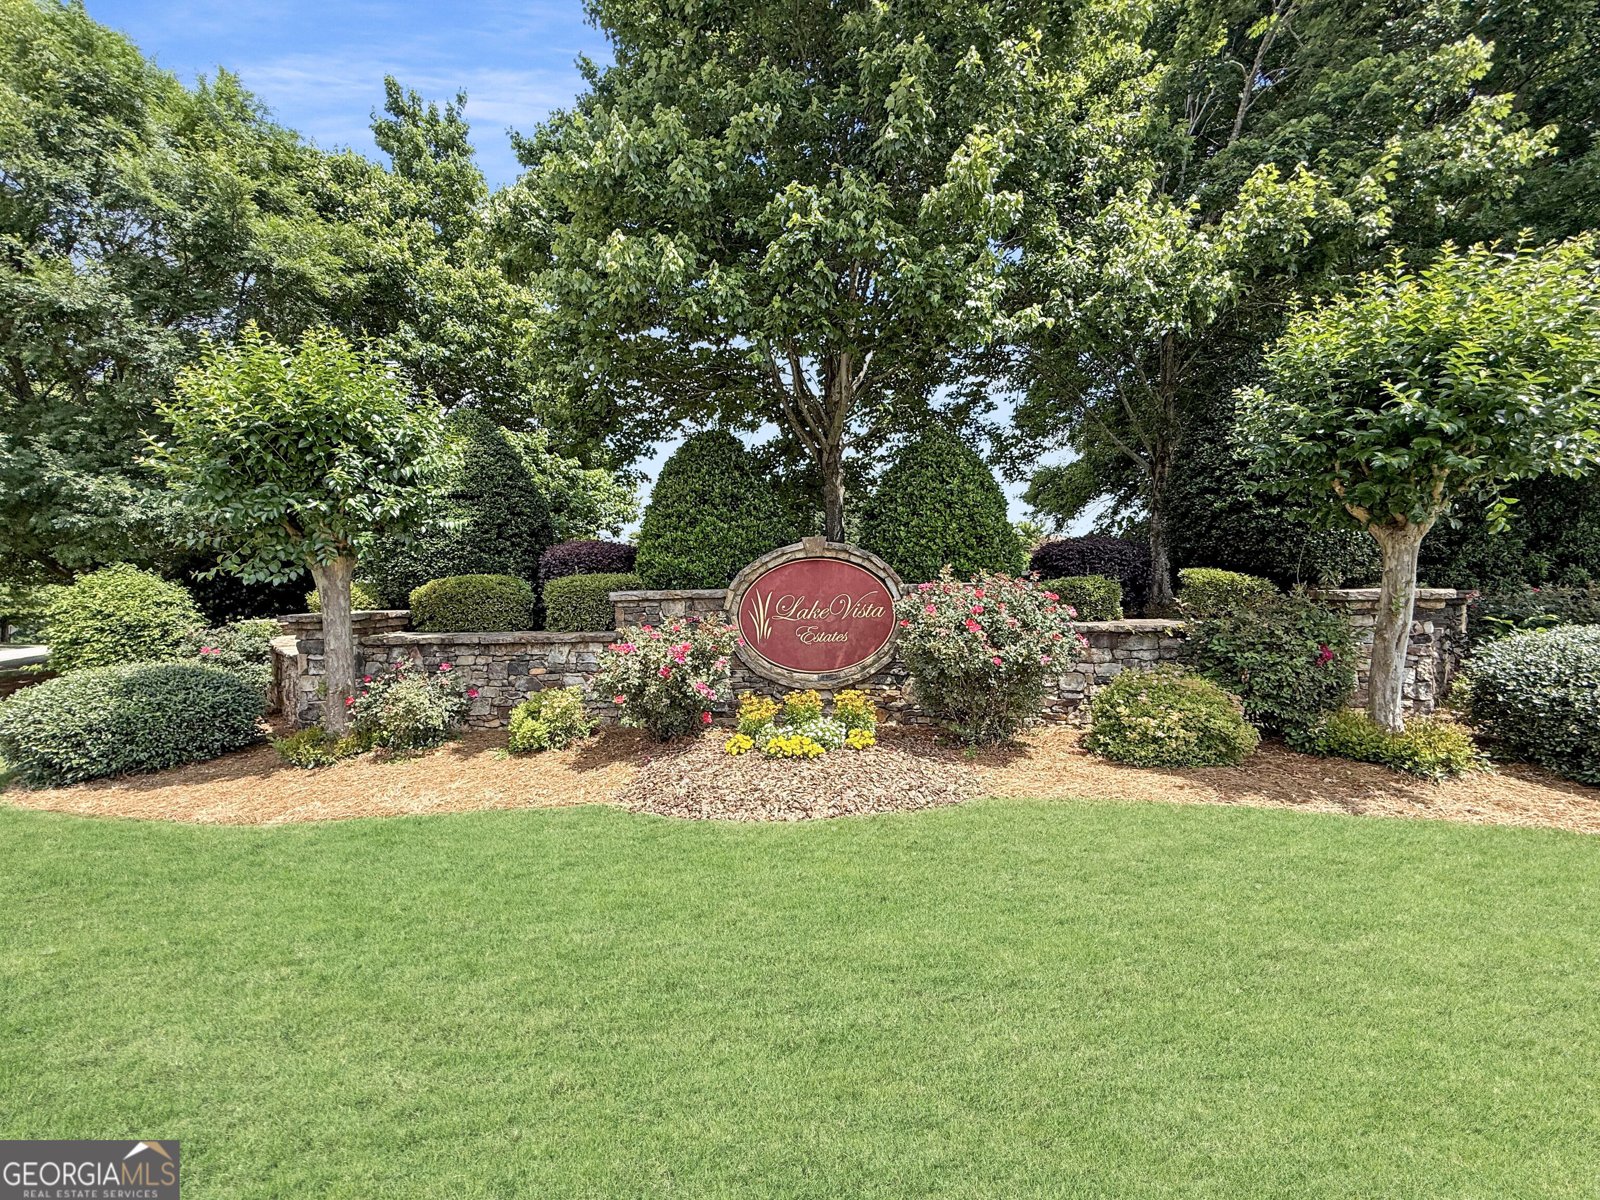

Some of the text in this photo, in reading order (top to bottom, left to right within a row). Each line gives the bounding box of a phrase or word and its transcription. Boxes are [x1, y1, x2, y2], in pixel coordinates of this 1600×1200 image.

[771, 590, 886, 622] Lake Vista
[795, 625, 849, 645] Estates
